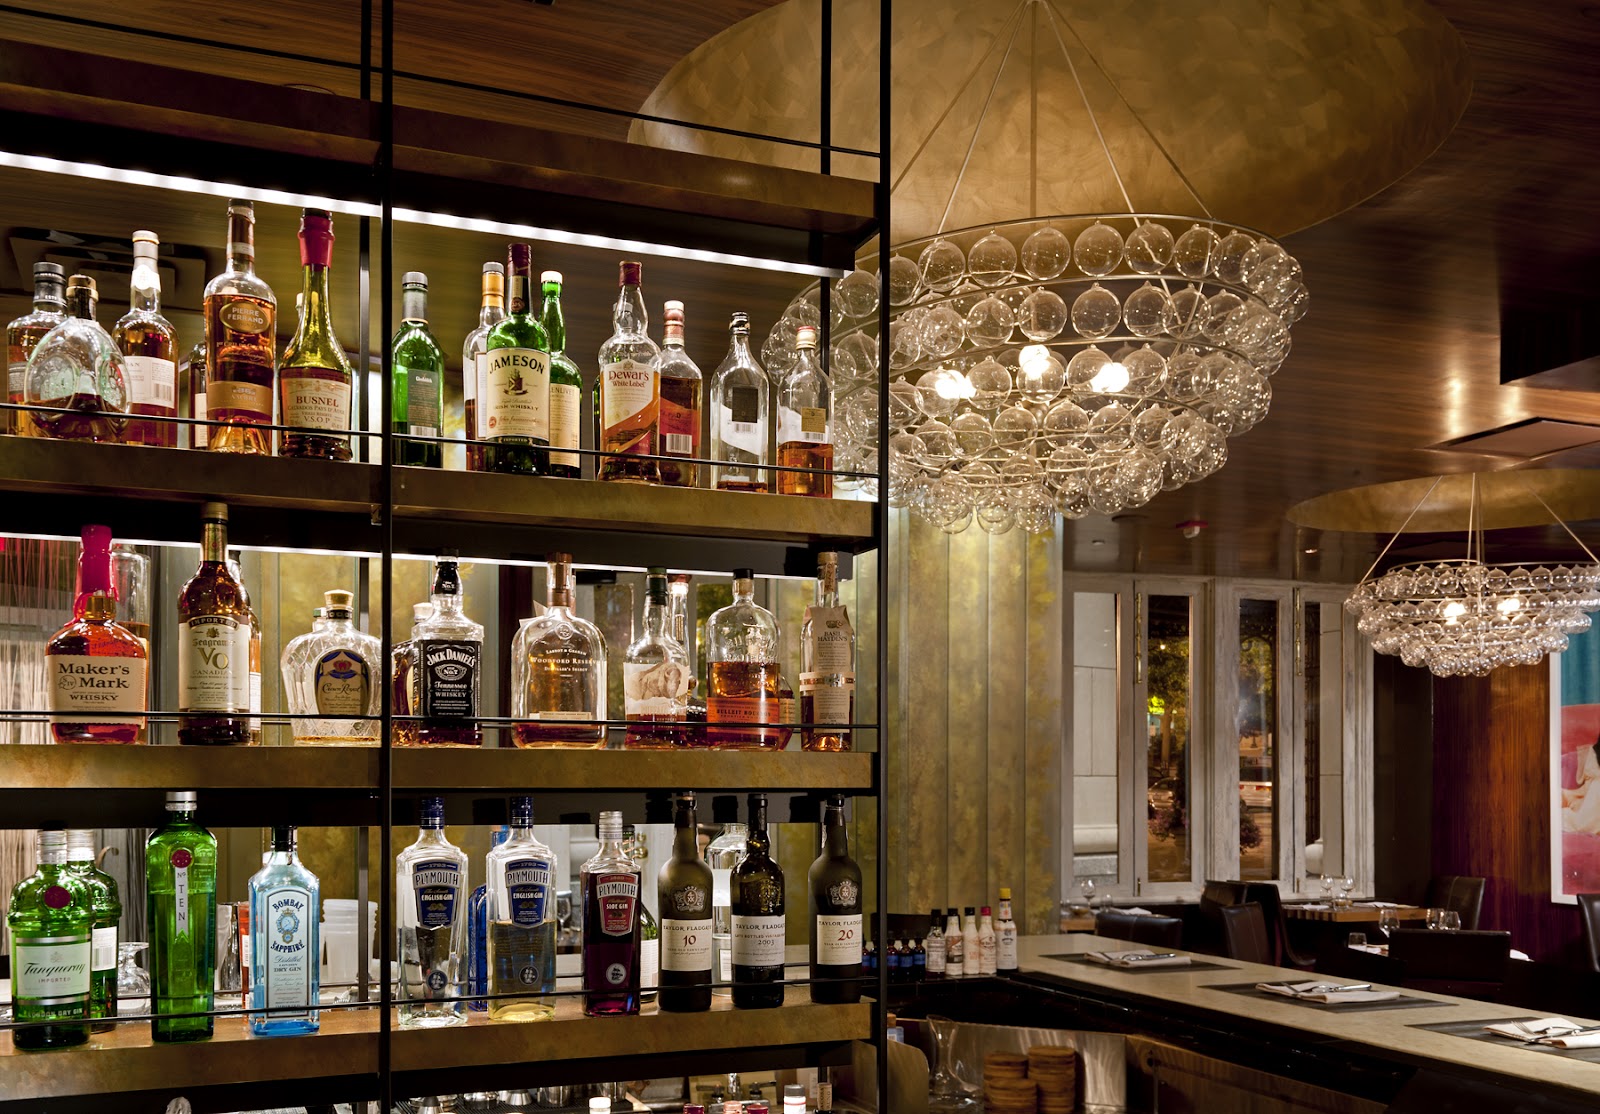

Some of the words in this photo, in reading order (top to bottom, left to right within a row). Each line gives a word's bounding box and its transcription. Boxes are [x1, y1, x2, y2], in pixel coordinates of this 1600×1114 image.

[232, 307, 259, 317] PIERRE
[227, 314, 264, 325] FERRAND
[489, 355, 545, 374] JAMESON
[608, 370, 649, 381] Dewar's
[296, 396, 339, 407] BUSNEL
[191, 617, 237, 627] IMPORTED
[197, 647, 229, 670] VO
[426, 651, 447, 666] JACK
[446, 648, 477, 668] DANIEL'S
[58, 663, 130, 675] Maker's
[78, 677, 130, 688] Mark
[322, 682, 341, 694] Crown
[415, 871, 459, 886] PLYMOUTH
[507, 870, 549, 884] PLYMOUTH
[598, 883, 636, 896] PLYMOUTH
[178, 884, 186, 921] TEN
[443, 893, 453, 901] GIN
[272, 899, 304, 912] BOMBAY
[735, 923, 761, 931] TAYLOR
[761, 922, 785, 930] FLADGAT
[683, 934, 697, 948] 10
[837, 929, 854, 941] 20
[270, 939, 306, 953] SAPPHIRE
[23, 962, 86, 977] Tanqueray
[73, 1007, 83, 1015] GIN
